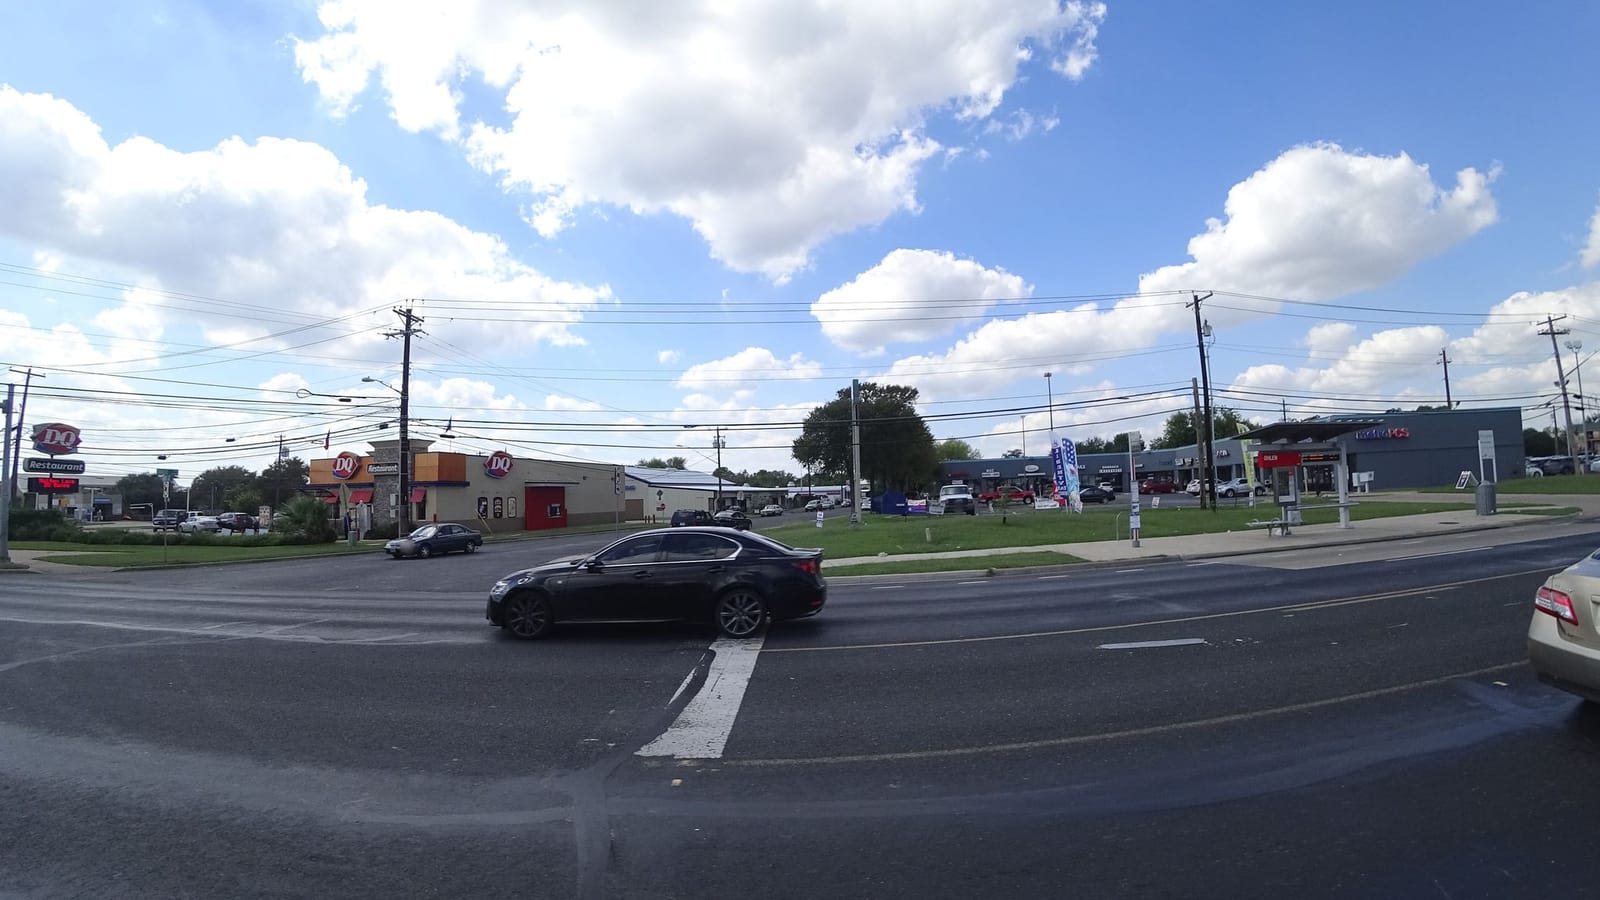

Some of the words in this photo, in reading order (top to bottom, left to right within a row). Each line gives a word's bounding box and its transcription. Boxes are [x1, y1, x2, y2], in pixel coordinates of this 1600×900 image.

[43, 429, 76, 448] DQ
[29, 461, 83, 471] Restaurant
[336, 458, 353, 472] DQ
[368, 464, 398, 472] Restaurant
[491, 457, 511, 472] DQ
[1054, 448, 1065, 485] LIBERTY
